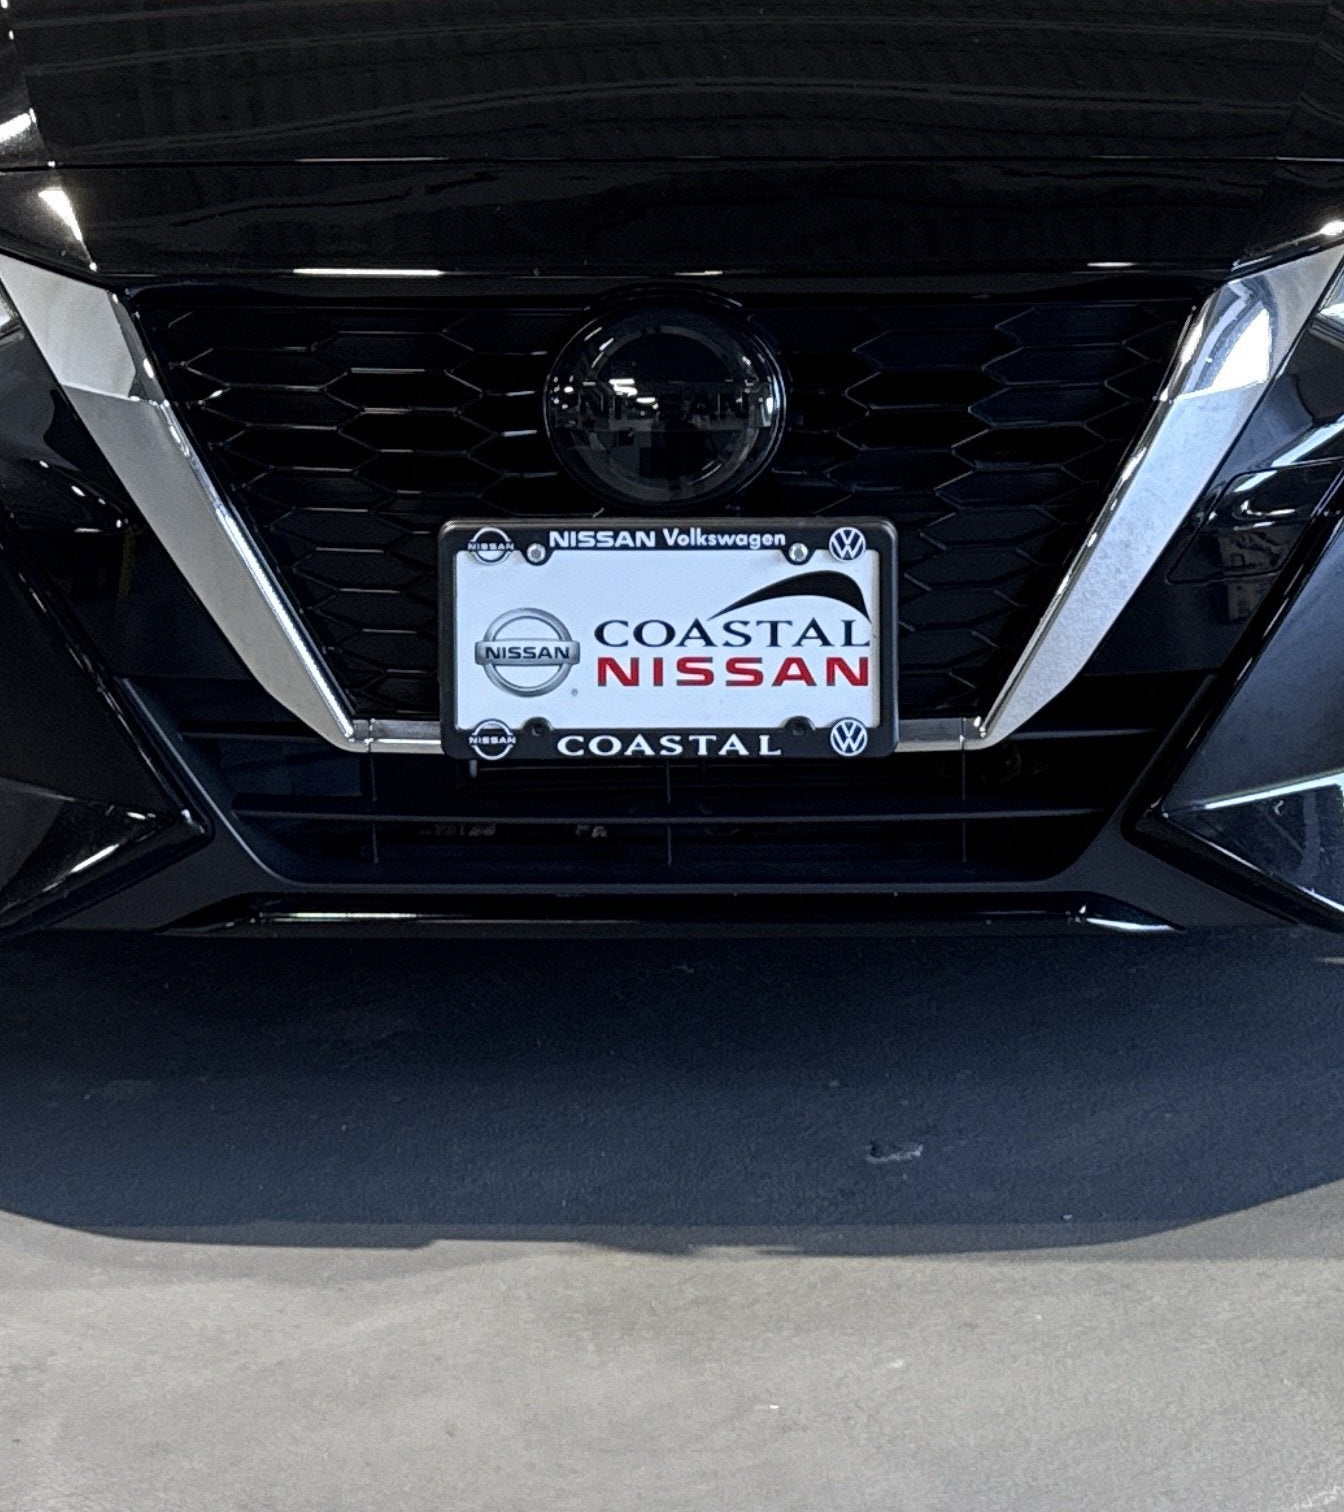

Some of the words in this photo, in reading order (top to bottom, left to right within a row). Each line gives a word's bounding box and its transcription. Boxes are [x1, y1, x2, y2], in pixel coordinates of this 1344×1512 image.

[549, 530, 656, 548] NISSAN
[662, 528, 786, 549] Volkswagen
[594, 617, 871, 648] COASTAL
[484, 645, 571, 660] NISSAN
[597, 656, 869, 688] NISSAN
[556, 734, 782, 757] COASTAL
